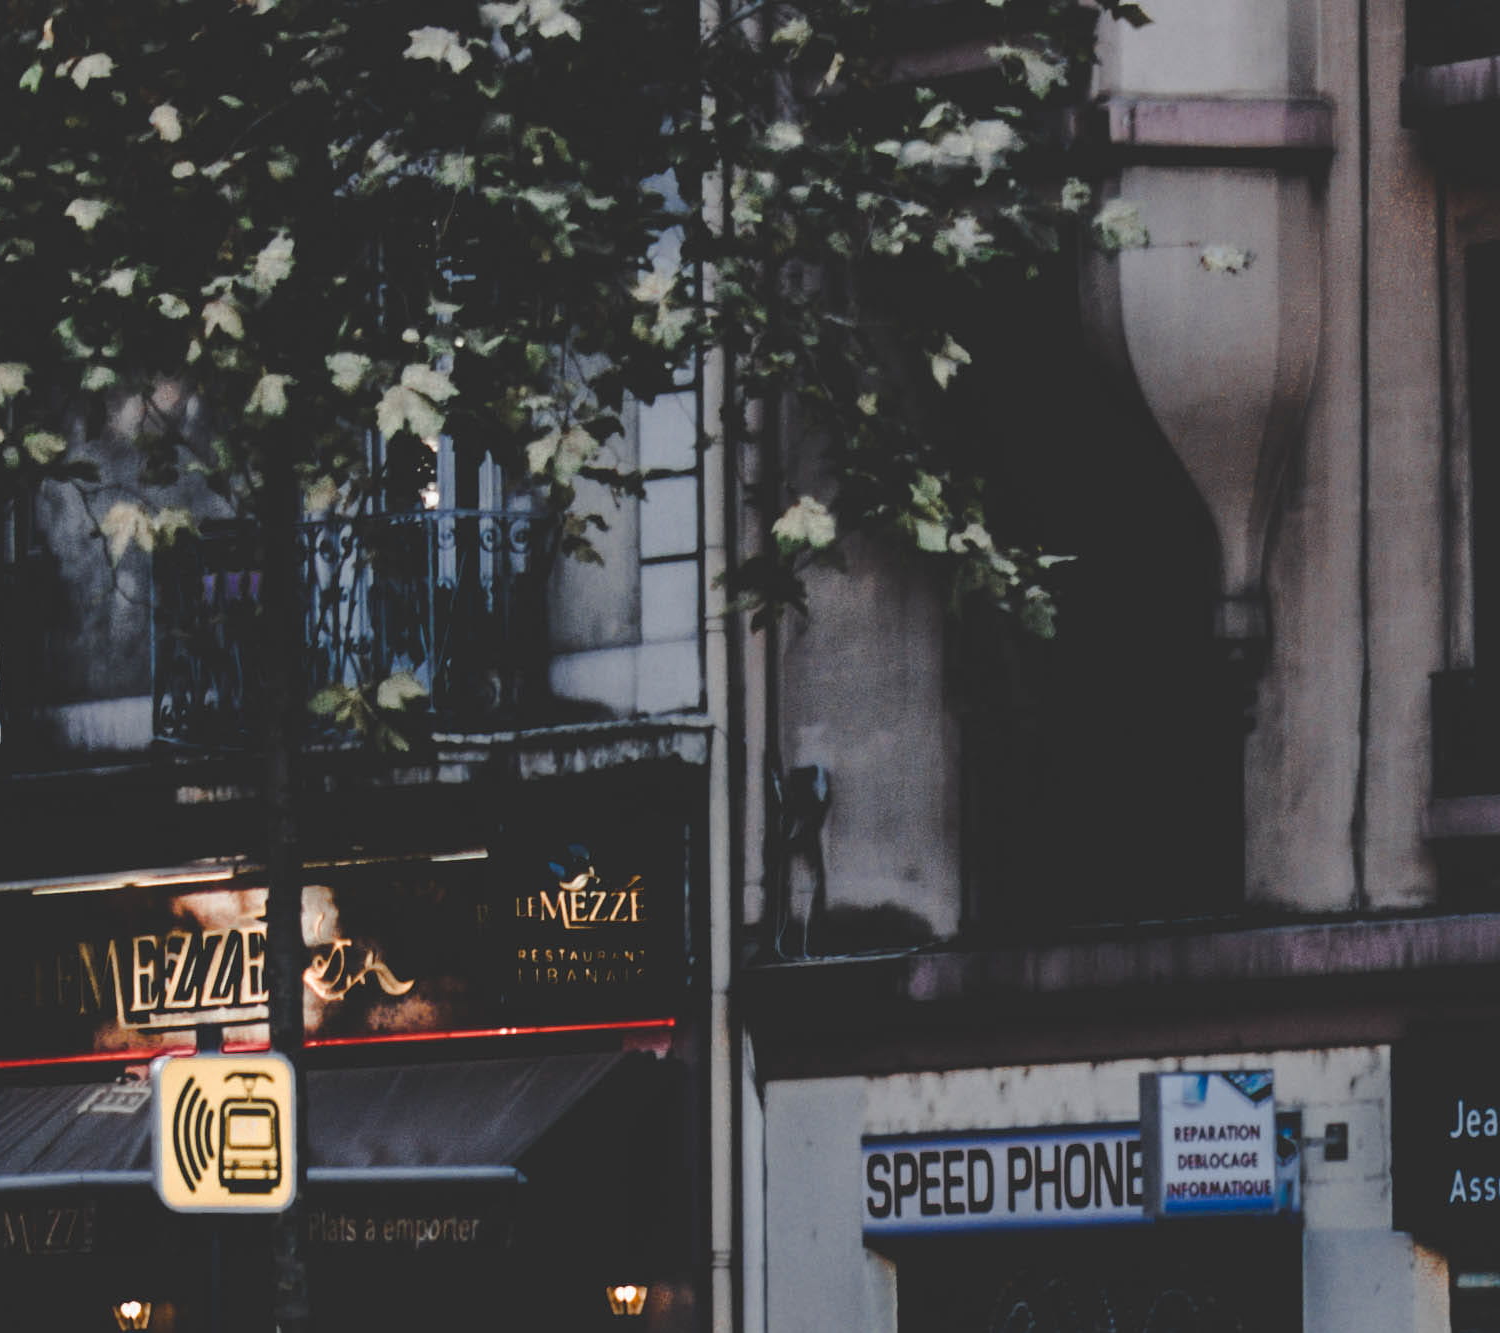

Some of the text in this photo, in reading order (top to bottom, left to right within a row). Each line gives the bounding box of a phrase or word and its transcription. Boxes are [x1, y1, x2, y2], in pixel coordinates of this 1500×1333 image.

[517, 948, 645, 962] RESTAURANT
[1174, 1124, 1261, 1143] REPARATION
[1177, 1152, 1258, 1171] DEBLOCAGE
[866, 1147, 994, 1218] SPEED
[1167, 1179, 1271, 1199] INFORMATIQUE
